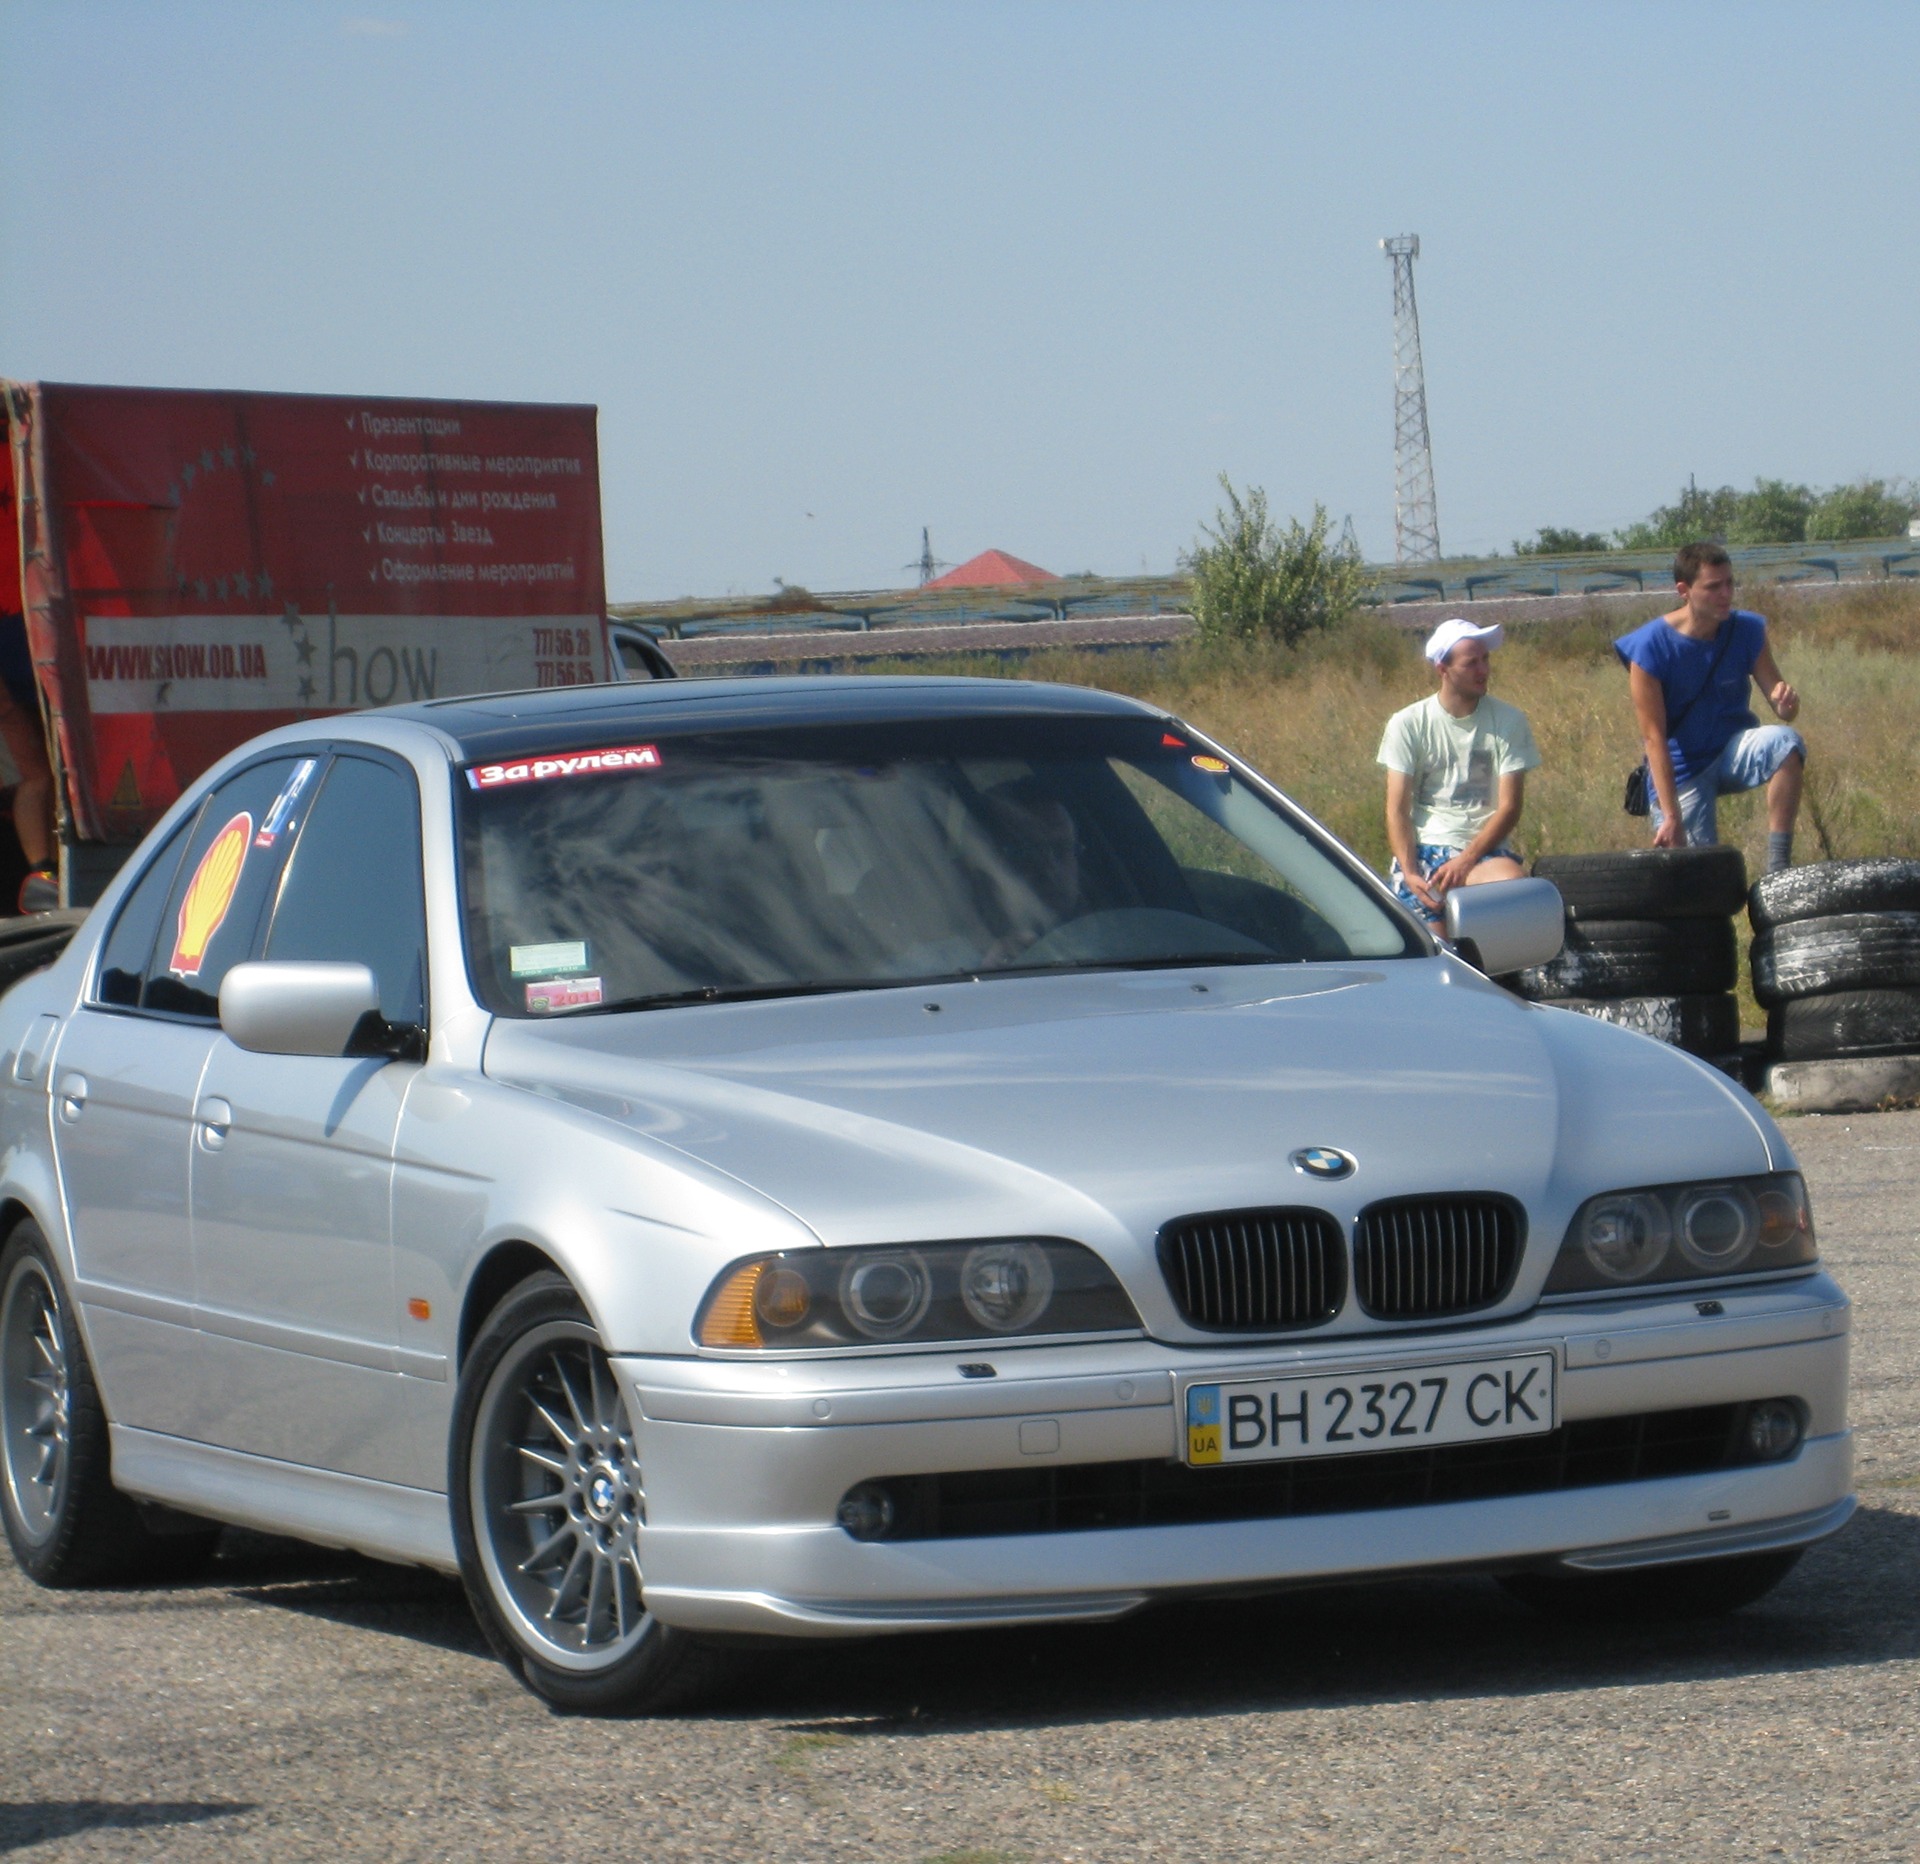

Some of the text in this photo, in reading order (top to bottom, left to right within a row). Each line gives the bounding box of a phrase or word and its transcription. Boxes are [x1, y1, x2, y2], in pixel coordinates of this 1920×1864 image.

[361, 412, 461, 438] Презентации
[366, 449, 581, 478] Корпоративные мероприятия
[372, 484, 557, 512] Свадьбы и дни рождения
[376, 521, 494, 549] Концерты Звезд
[382, 557, 576, 585] Оформление мероприятий
[480, 765, 529, 784] За
[1228, 1367, 1540, 1450] BH 2327 CK
[1193, 1437, 1219, 1453] UA
